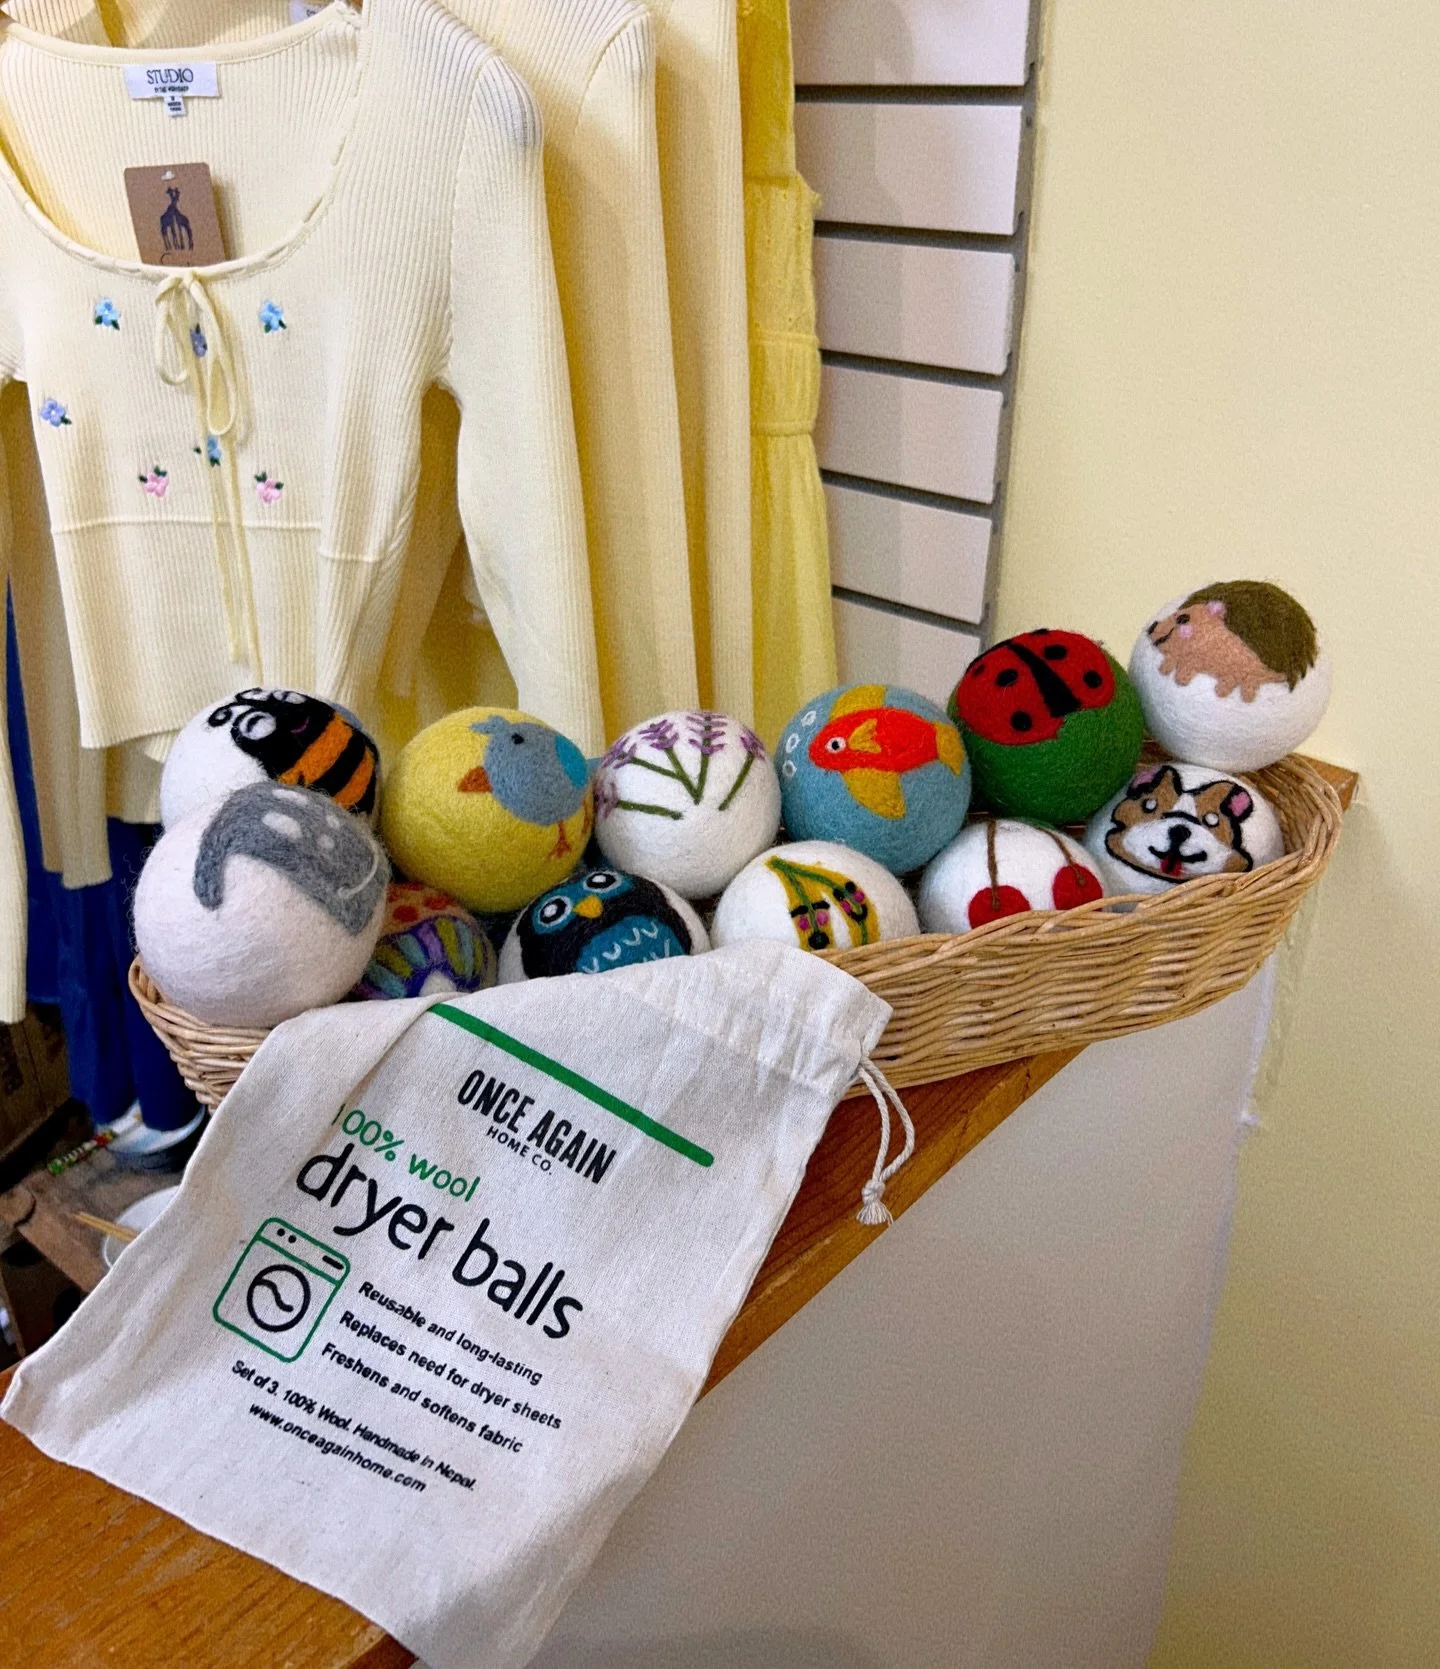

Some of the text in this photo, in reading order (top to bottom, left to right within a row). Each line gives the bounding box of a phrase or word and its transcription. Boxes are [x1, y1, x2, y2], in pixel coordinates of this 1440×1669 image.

[146, 68, 194, 84] STUDIO
[408, 1153, 481, 1202] wool
[457, 1069, 617, 1184] ONCE AGAIN
[486, 1125, 552, 1176] HOME CO.
[296, 1143, 583, 1339] dryer balls
[339, 1310, 562, 1429] Replaces need for dryer sheets
[358, 1281, 543, 1386] Reusable and long-lasting
[232, 1360, 476, 1491] Set of 3. 100% Wool. Handmade in Nepal.
[249, 1403, 427, 1492] www.onceagainhome.com
[321, 1342, 523, 1454] Freshens and softens fabric
